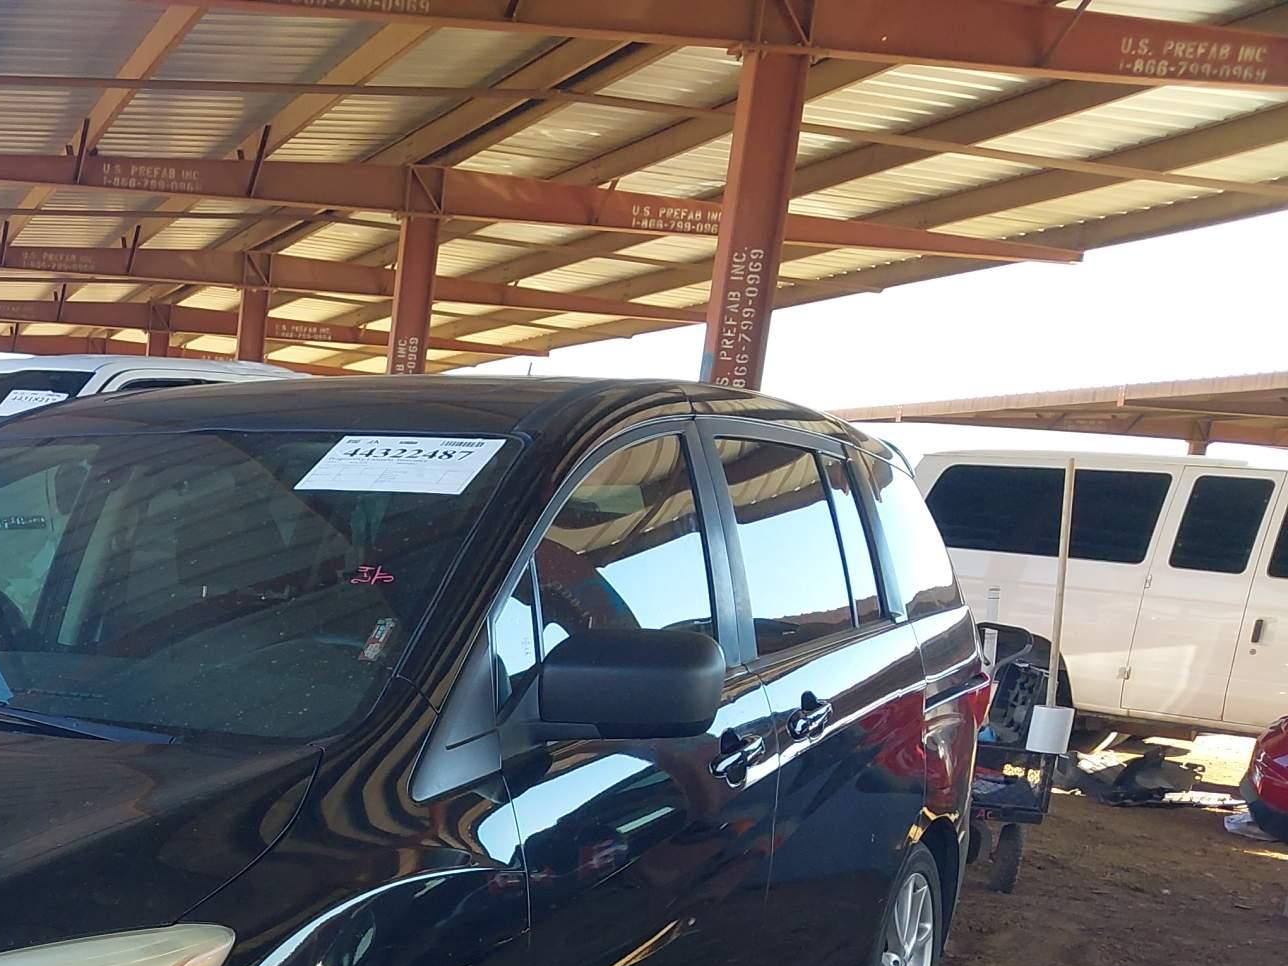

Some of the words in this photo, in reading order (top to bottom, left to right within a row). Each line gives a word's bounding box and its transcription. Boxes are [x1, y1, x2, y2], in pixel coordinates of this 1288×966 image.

[1120, 36, 1153, 57] U.S.
[1163, 40, 1231, 60] PREFAB
[1119, 58, 1268, 81] 1-866-799-0969
[130, 165, 177, 180] PREFAB
[658, 207, 702, 221] PREFAB
[730, 247, 748, 281] INC.
[719, 290, 742, 362] PREFAB
[343, 447, 473, 460] 44322487
